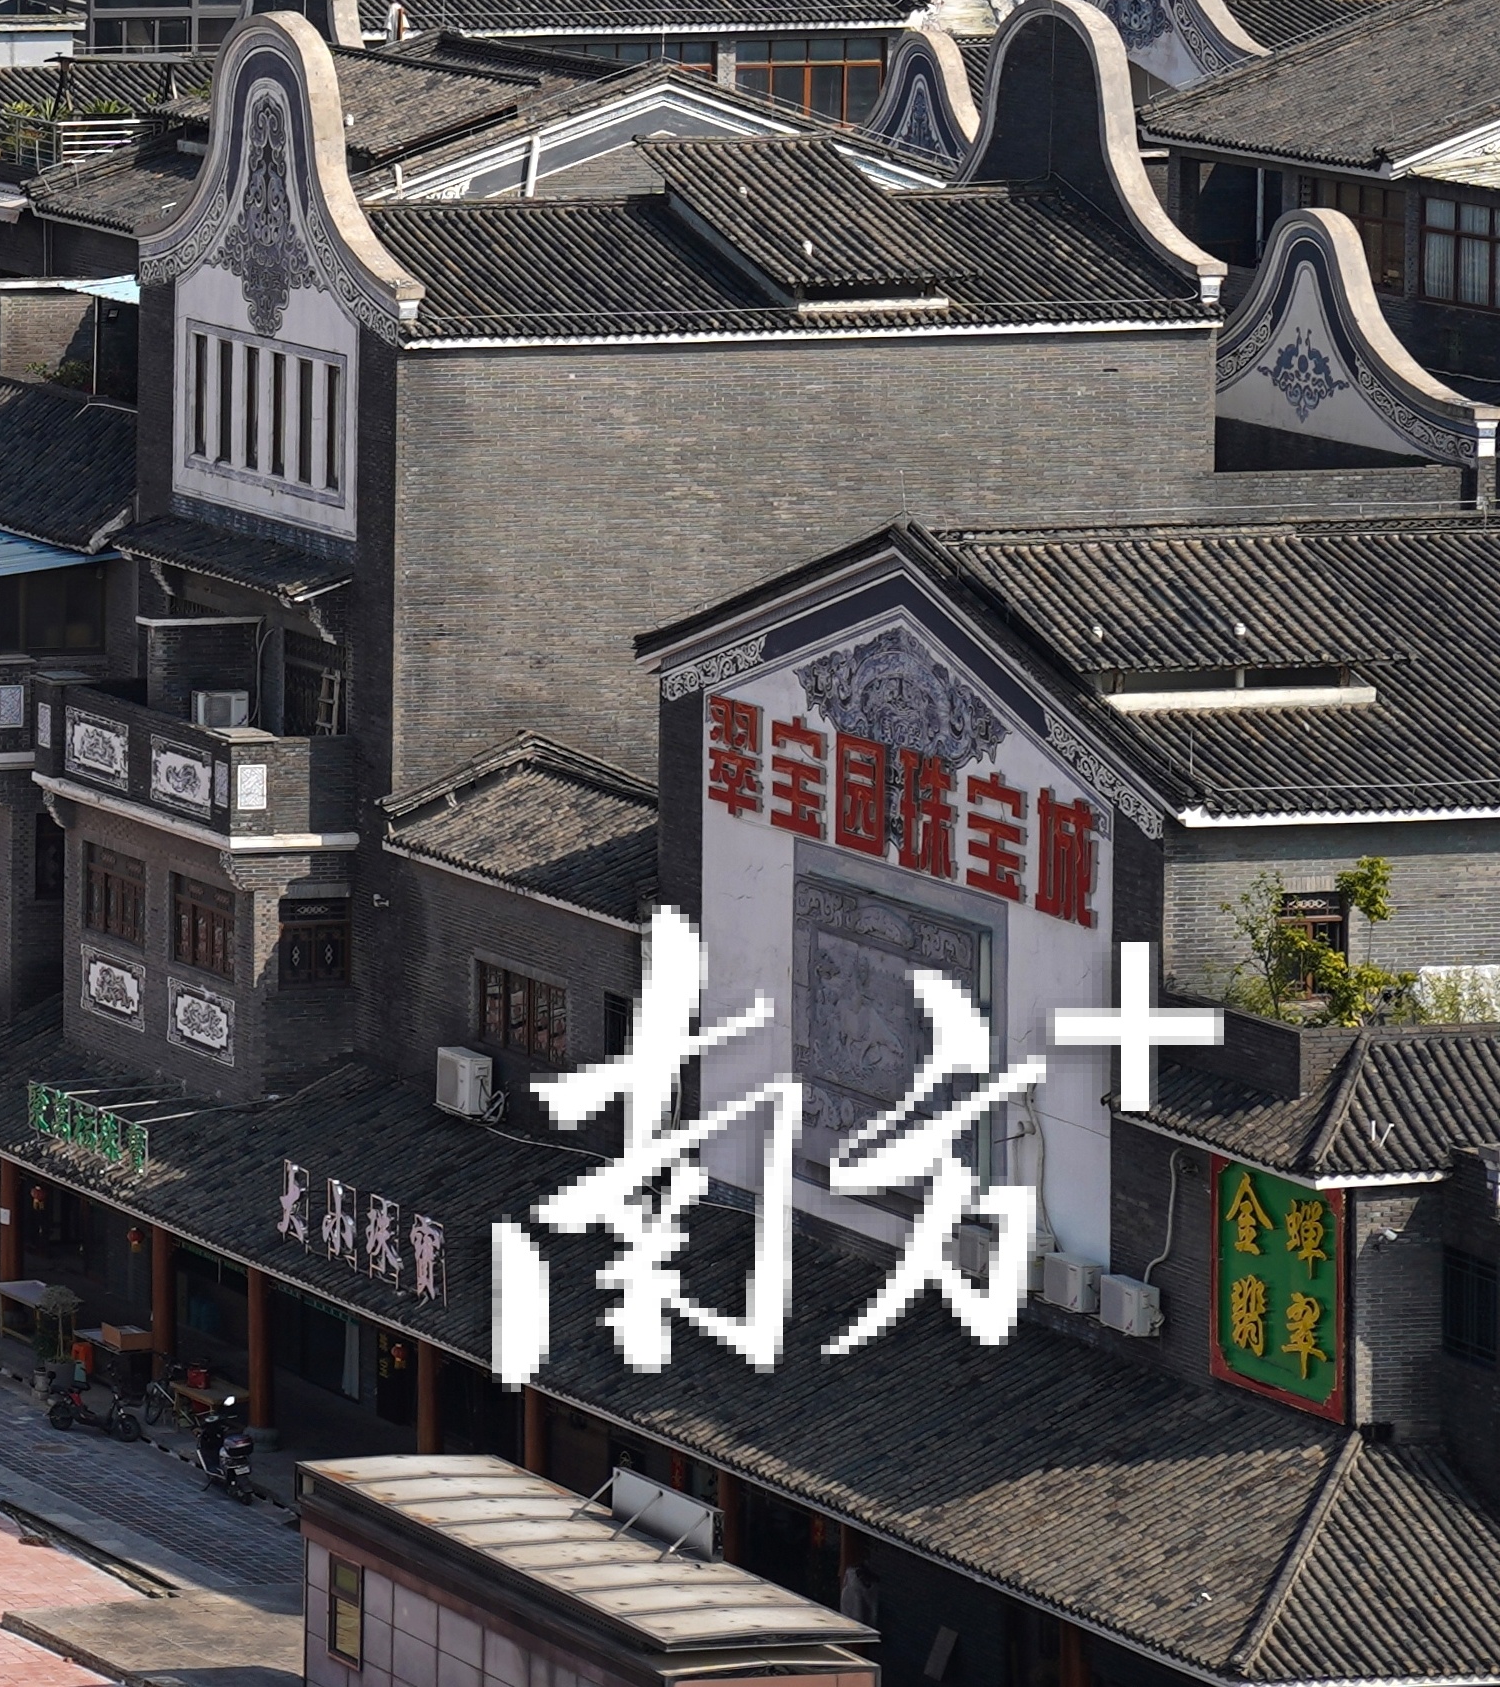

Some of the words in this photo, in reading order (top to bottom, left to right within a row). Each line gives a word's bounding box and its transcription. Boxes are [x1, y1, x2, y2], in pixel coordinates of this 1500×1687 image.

[708, 696, 1099, 929] 翠宝园珠宝城
[1231, 1274, 1327, 1380] 翡翠
